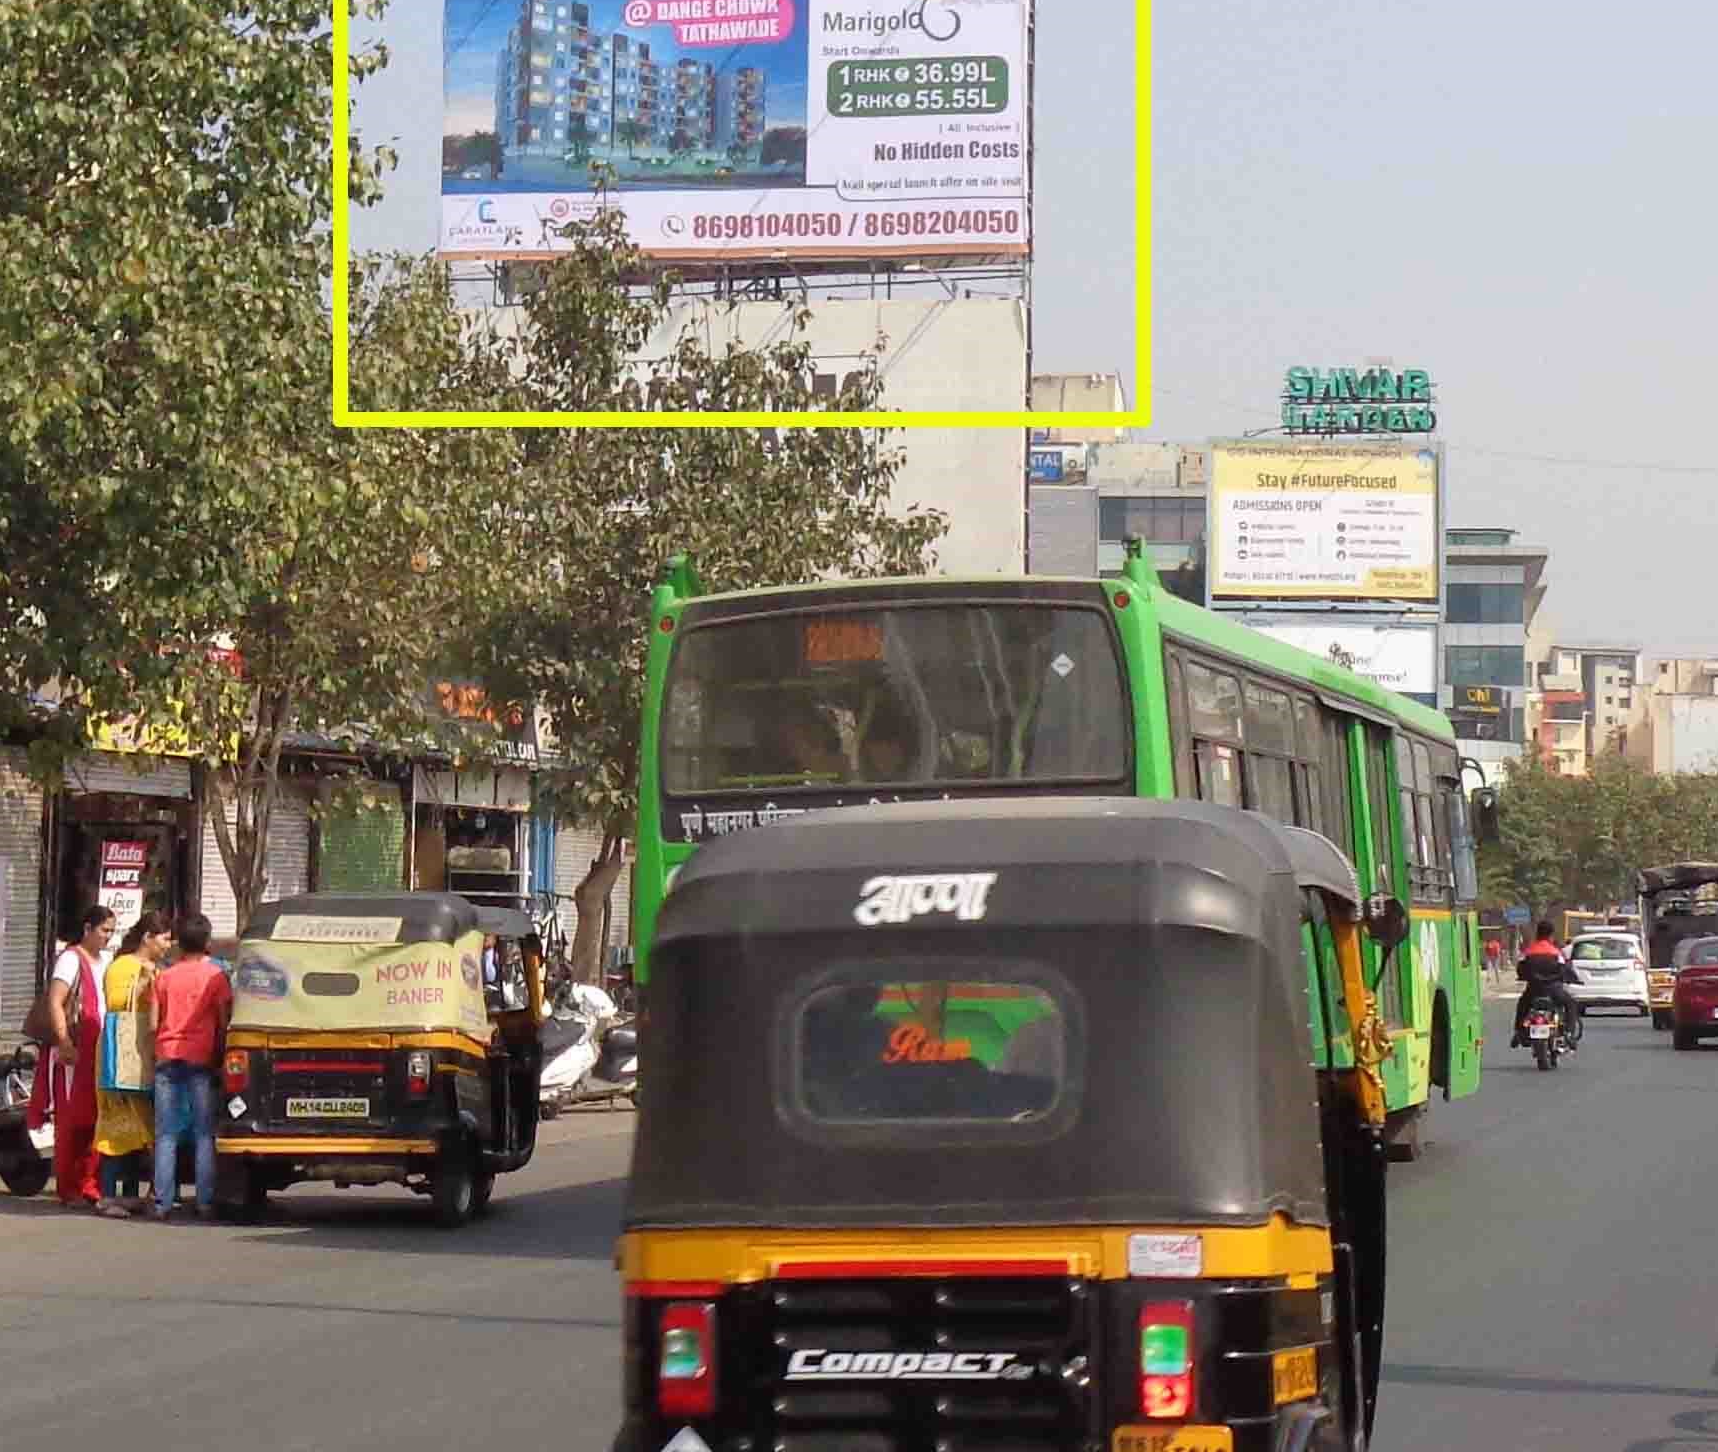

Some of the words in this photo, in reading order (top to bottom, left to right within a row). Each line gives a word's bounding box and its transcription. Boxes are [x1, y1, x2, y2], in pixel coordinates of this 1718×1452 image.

[680, 18, 780, 42] TATHAWADE
[839, 66, 850, 86] 1
[914, 61, 996, 84] 36.99L
[839, 92, 853, 112] 2
[915, 88, 996, 110] 55.55L
[874, 143, 897, 161] No
[901, 141, 964, 161] Hidden
[969, 140, 1020, 159] Costs
[693, 213, 841, 238] 8698104050
[864, 210, 1019, 237] 8698204050
[1256, 473, 1287, 490] Stay
[1290, 472, 1398, 490] #FutureFocused
[1232, 499, 1293, 512] ADMISSIONS
[1295, 499, 1323, 511] OPEN
[106, 842, 143, 862] Bata
[376, 960, 428, 984] NOW
[436, 959, 452, 979] IN
[386, 986, 444, 1006] BANER
